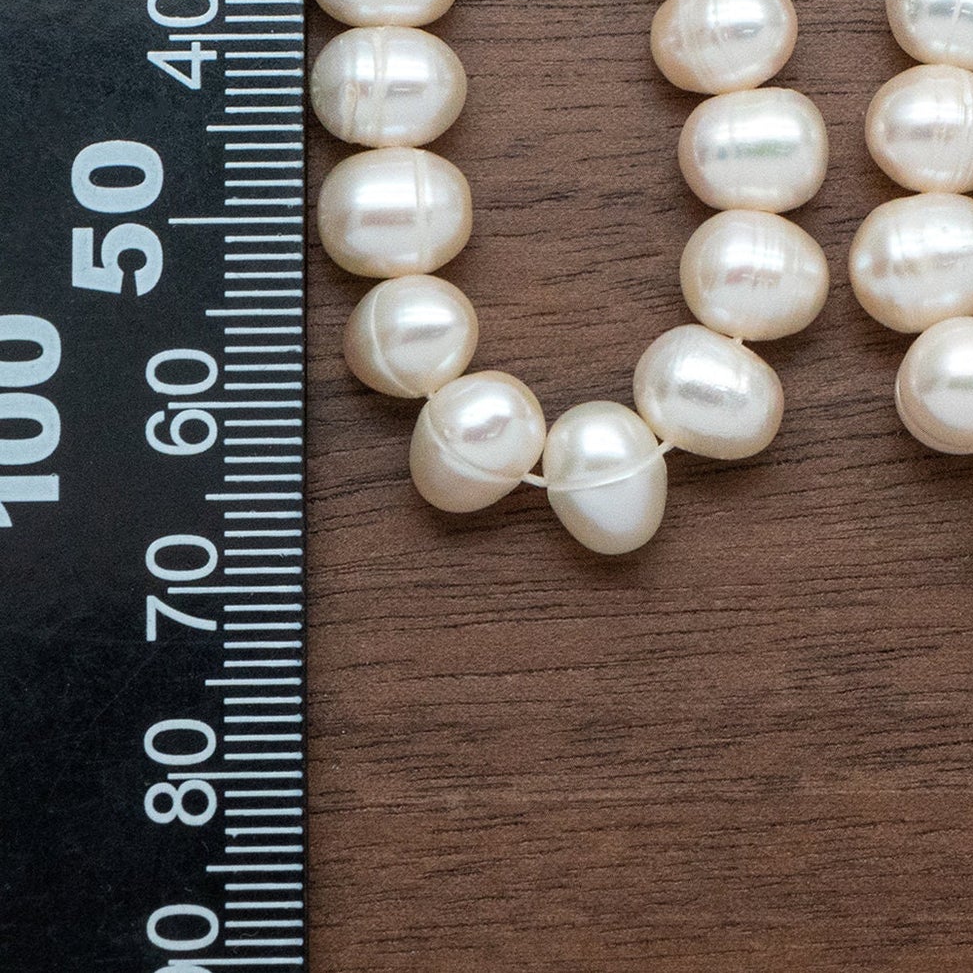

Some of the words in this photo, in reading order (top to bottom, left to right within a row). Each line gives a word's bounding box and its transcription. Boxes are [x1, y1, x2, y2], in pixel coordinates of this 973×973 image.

[72, 140, 163, 296] 50
[0, 315, 61, 527] 100
[146, 349, 218, 455] 60
[146, 535, 218, 641] 70
[144, 719, 218, 825] 80
[147, 904, 219, 973] 0
